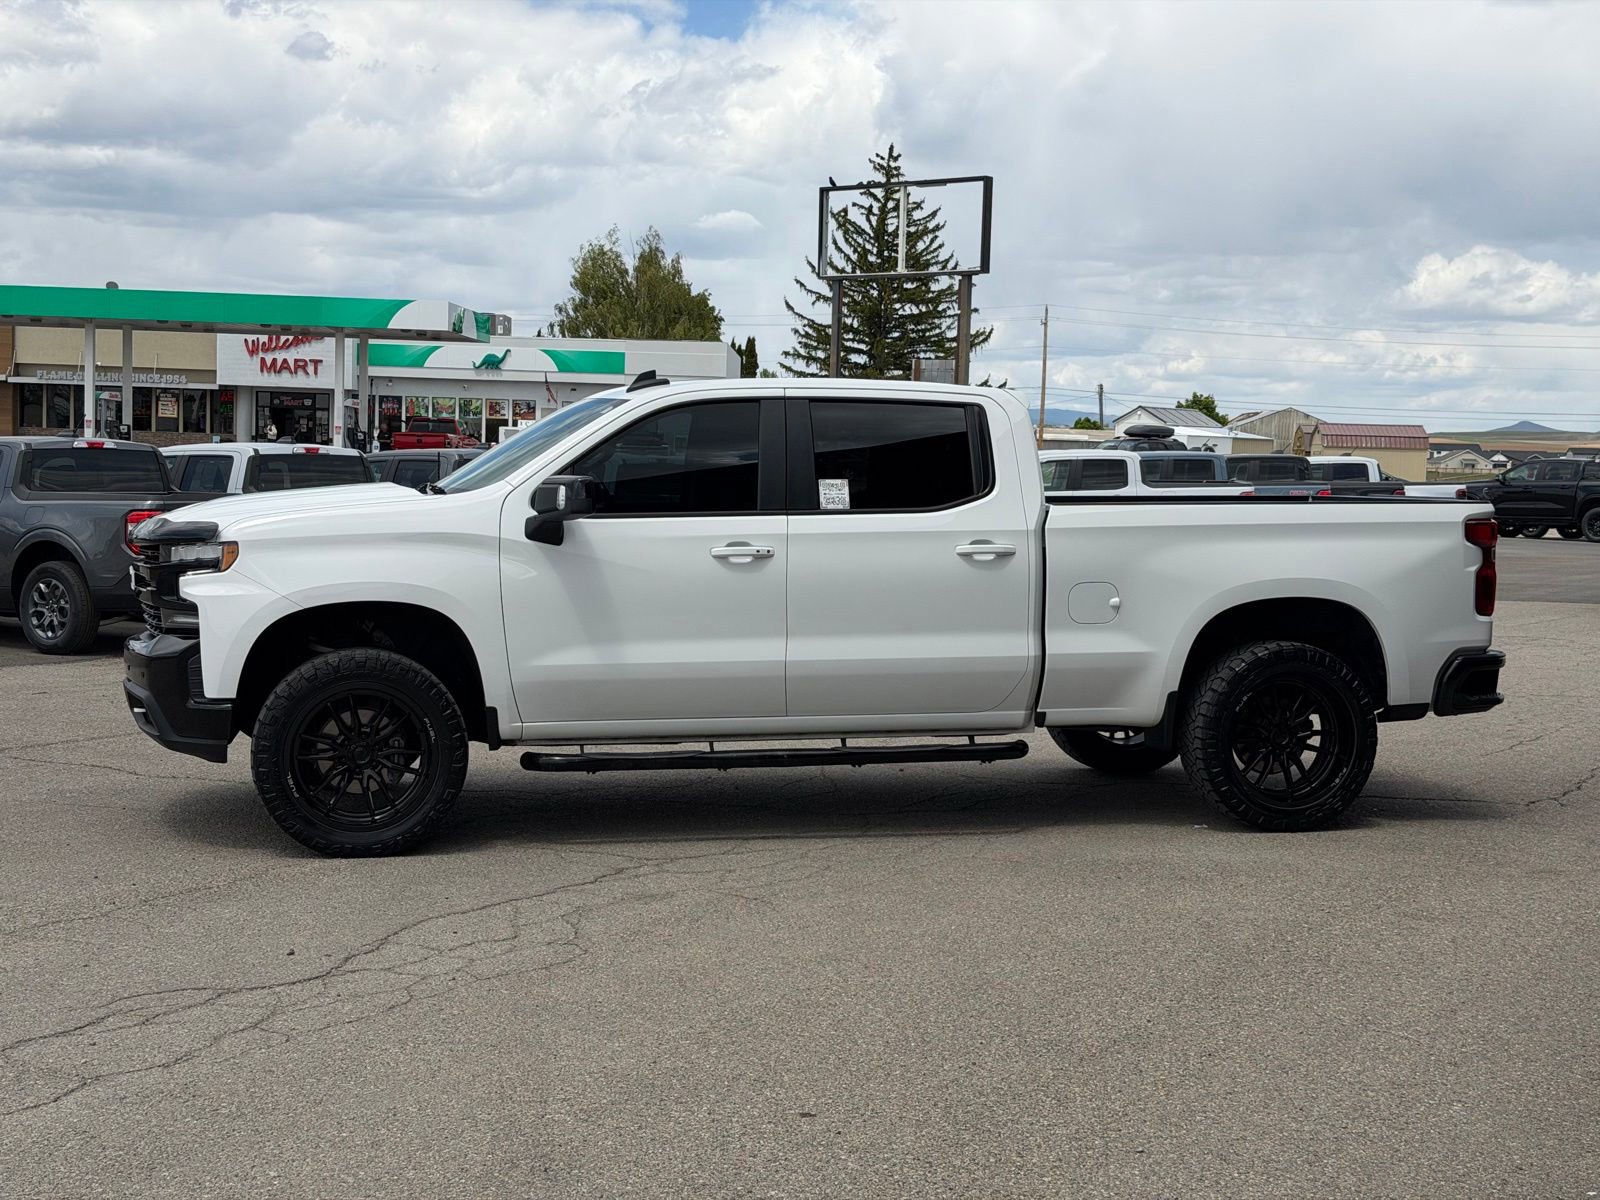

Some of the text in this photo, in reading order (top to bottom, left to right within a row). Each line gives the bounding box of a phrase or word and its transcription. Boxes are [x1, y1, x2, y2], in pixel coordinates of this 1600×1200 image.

[244, 335, 324, 357] Wellco
[36, 370, 73, 381] FLAME
[75, 371, 123, 383] GLLING
[162, 374, 187, 384] 1954
[260, 357, 323, 376] MART
[423, 717, 436, 743] FUEL
[287, 769, 300, 798] FUEL
